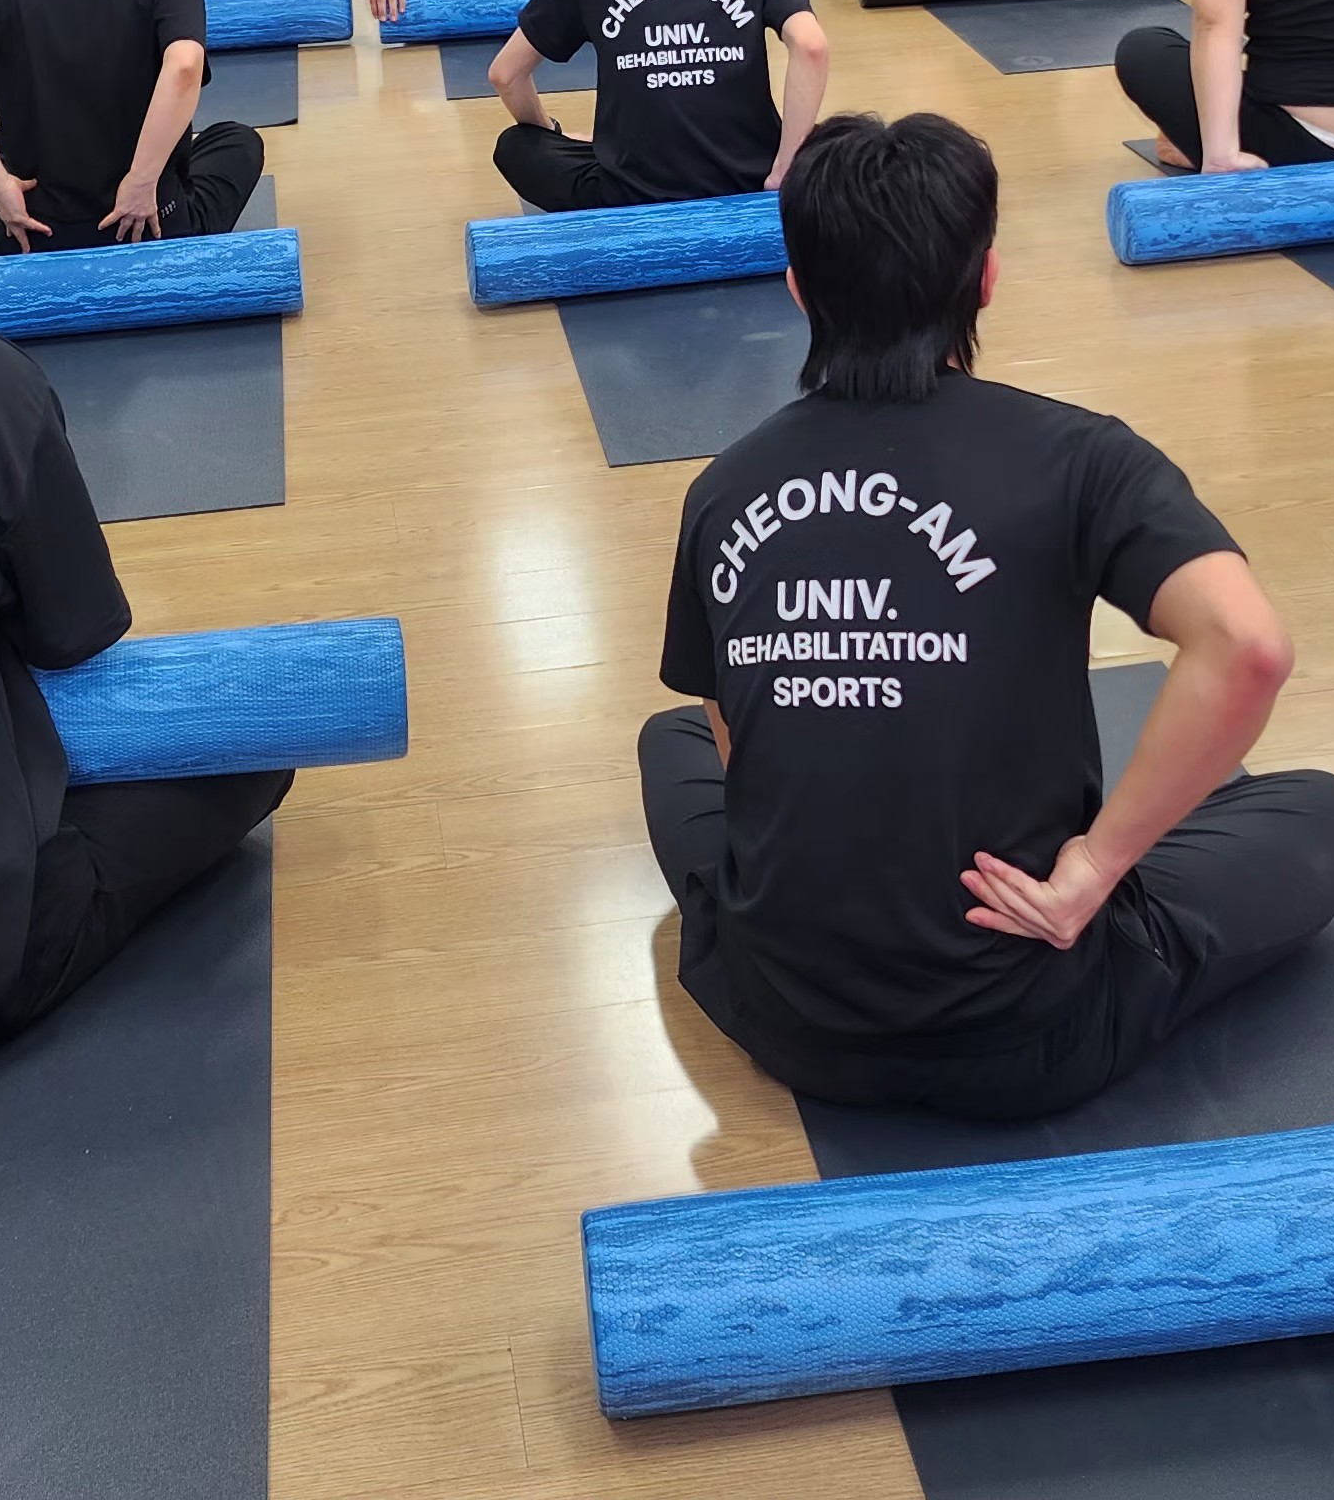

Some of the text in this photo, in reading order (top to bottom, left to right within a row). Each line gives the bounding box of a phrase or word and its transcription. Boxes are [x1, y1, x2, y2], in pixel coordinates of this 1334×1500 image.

[644, 23, 710, 47] UNIV.
[617, 47, 744, 70] REHABILITATION
[646, 69, 715, 89] SPORTS
[711, 469, 997, 604] CHEONG-AM
[777, 578, 897, 621] UNIV.
[727, 632, 967, 667] REHABILITATION
[773, 677, 903, 708] SPORTS
